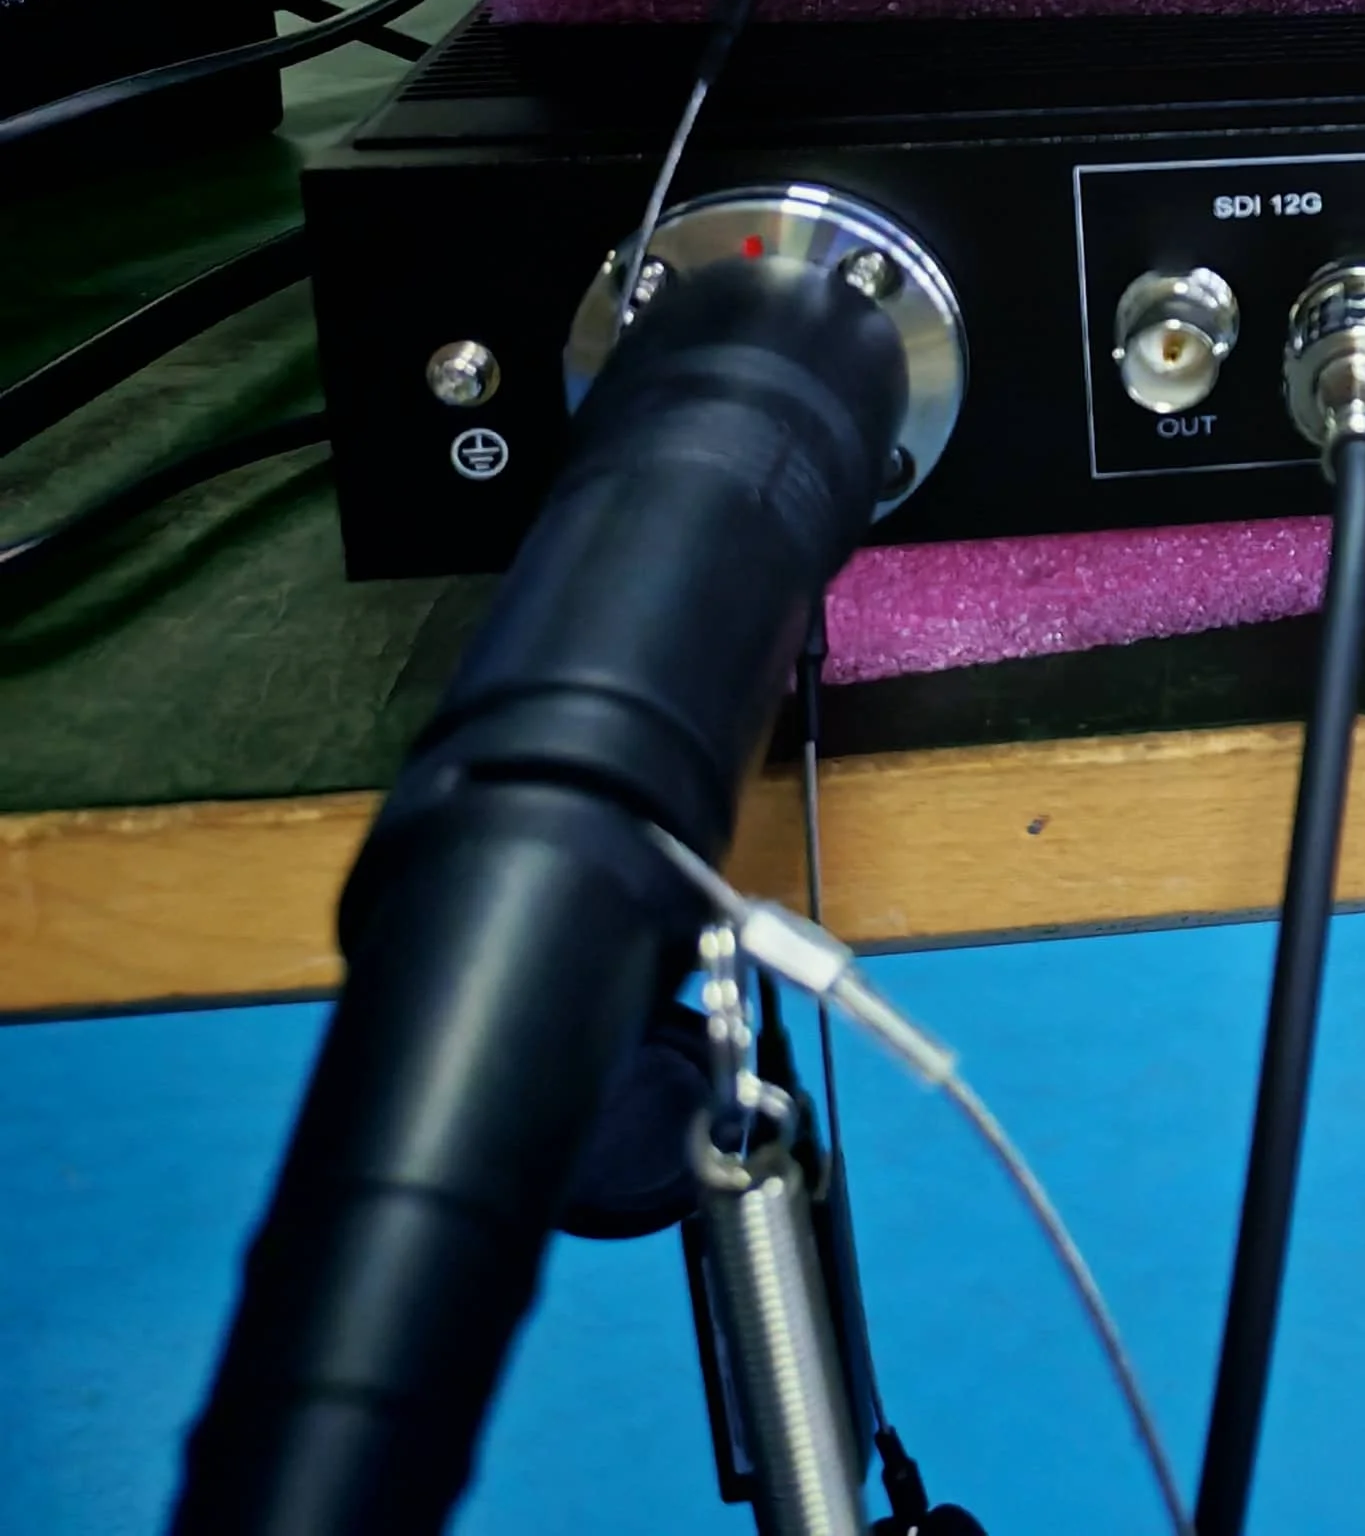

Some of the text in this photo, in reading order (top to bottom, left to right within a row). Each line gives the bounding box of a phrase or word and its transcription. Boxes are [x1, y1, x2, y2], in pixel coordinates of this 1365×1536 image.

[1214, 191, 1323, 219] SDI 12G
[1156, 414, 1218, 438] OUT
